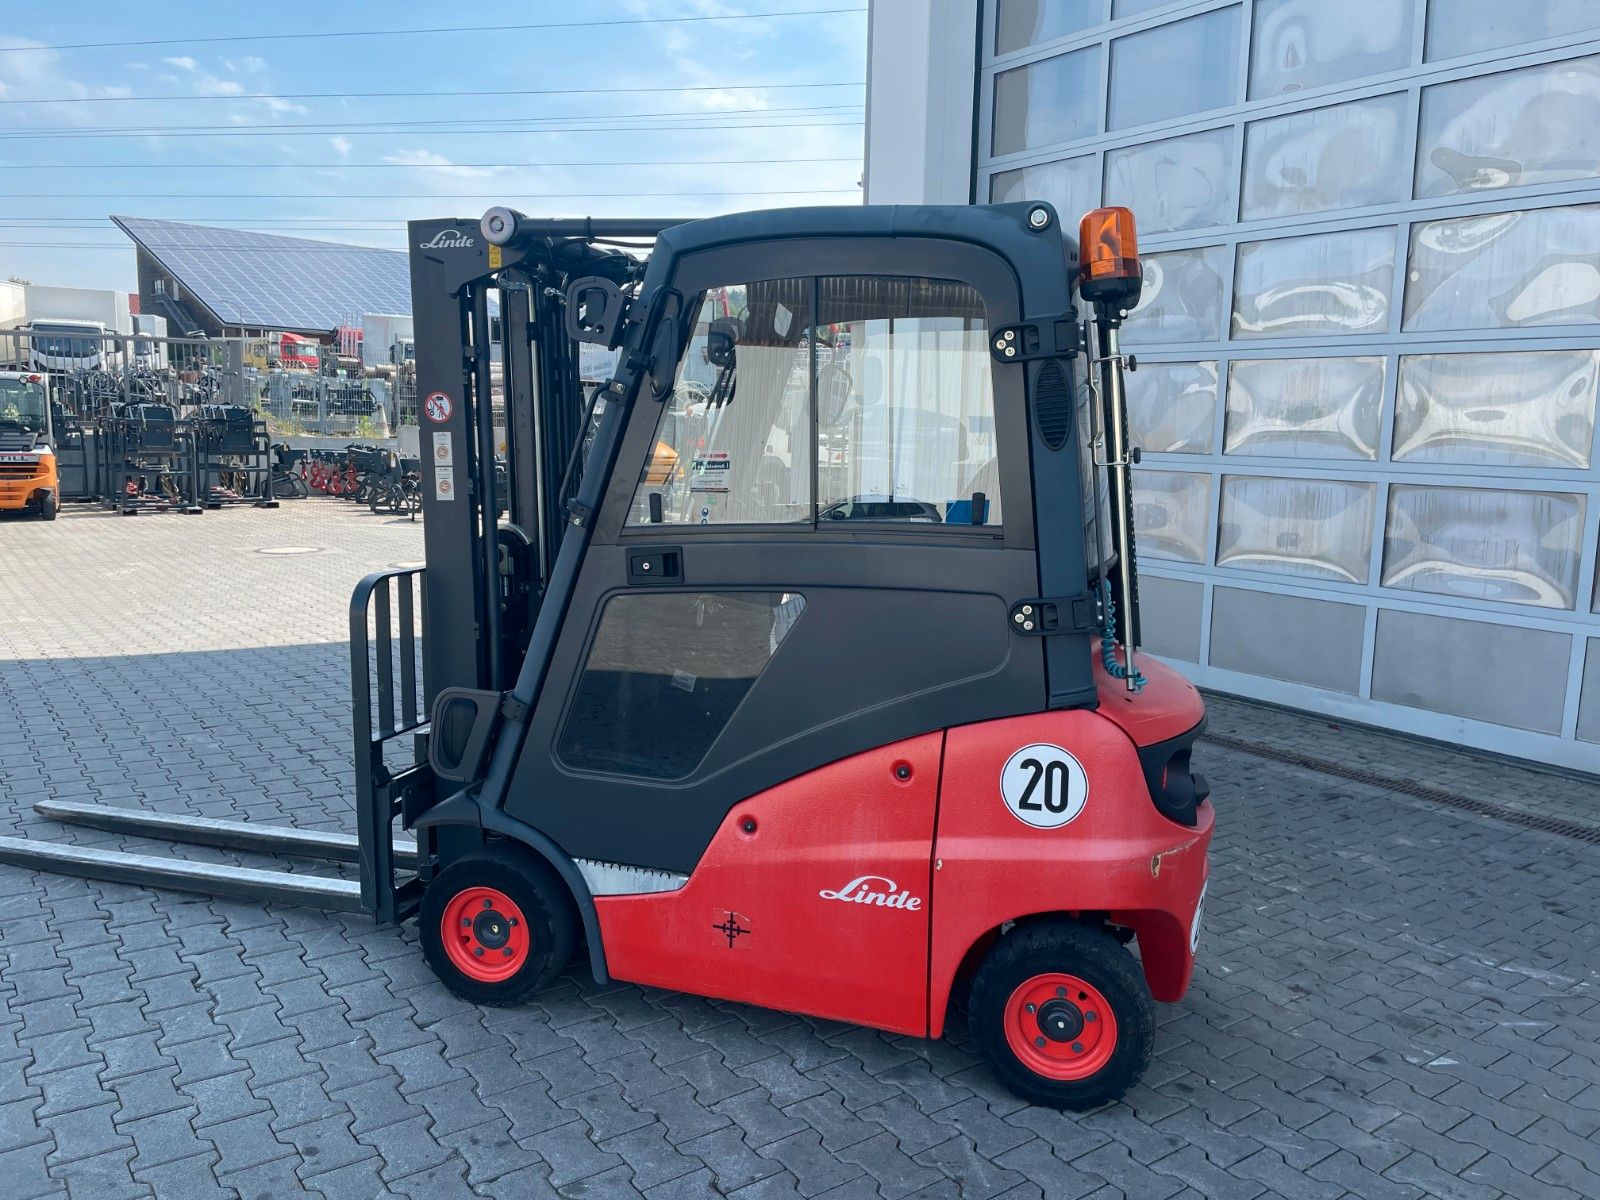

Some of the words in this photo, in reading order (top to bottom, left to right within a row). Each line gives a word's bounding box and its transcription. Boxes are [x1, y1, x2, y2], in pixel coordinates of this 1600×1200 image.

[420, 229, 474, 249] Linde
[1018, 758, 1070, 814] 20
[819, 875, 921, 911] Linde
